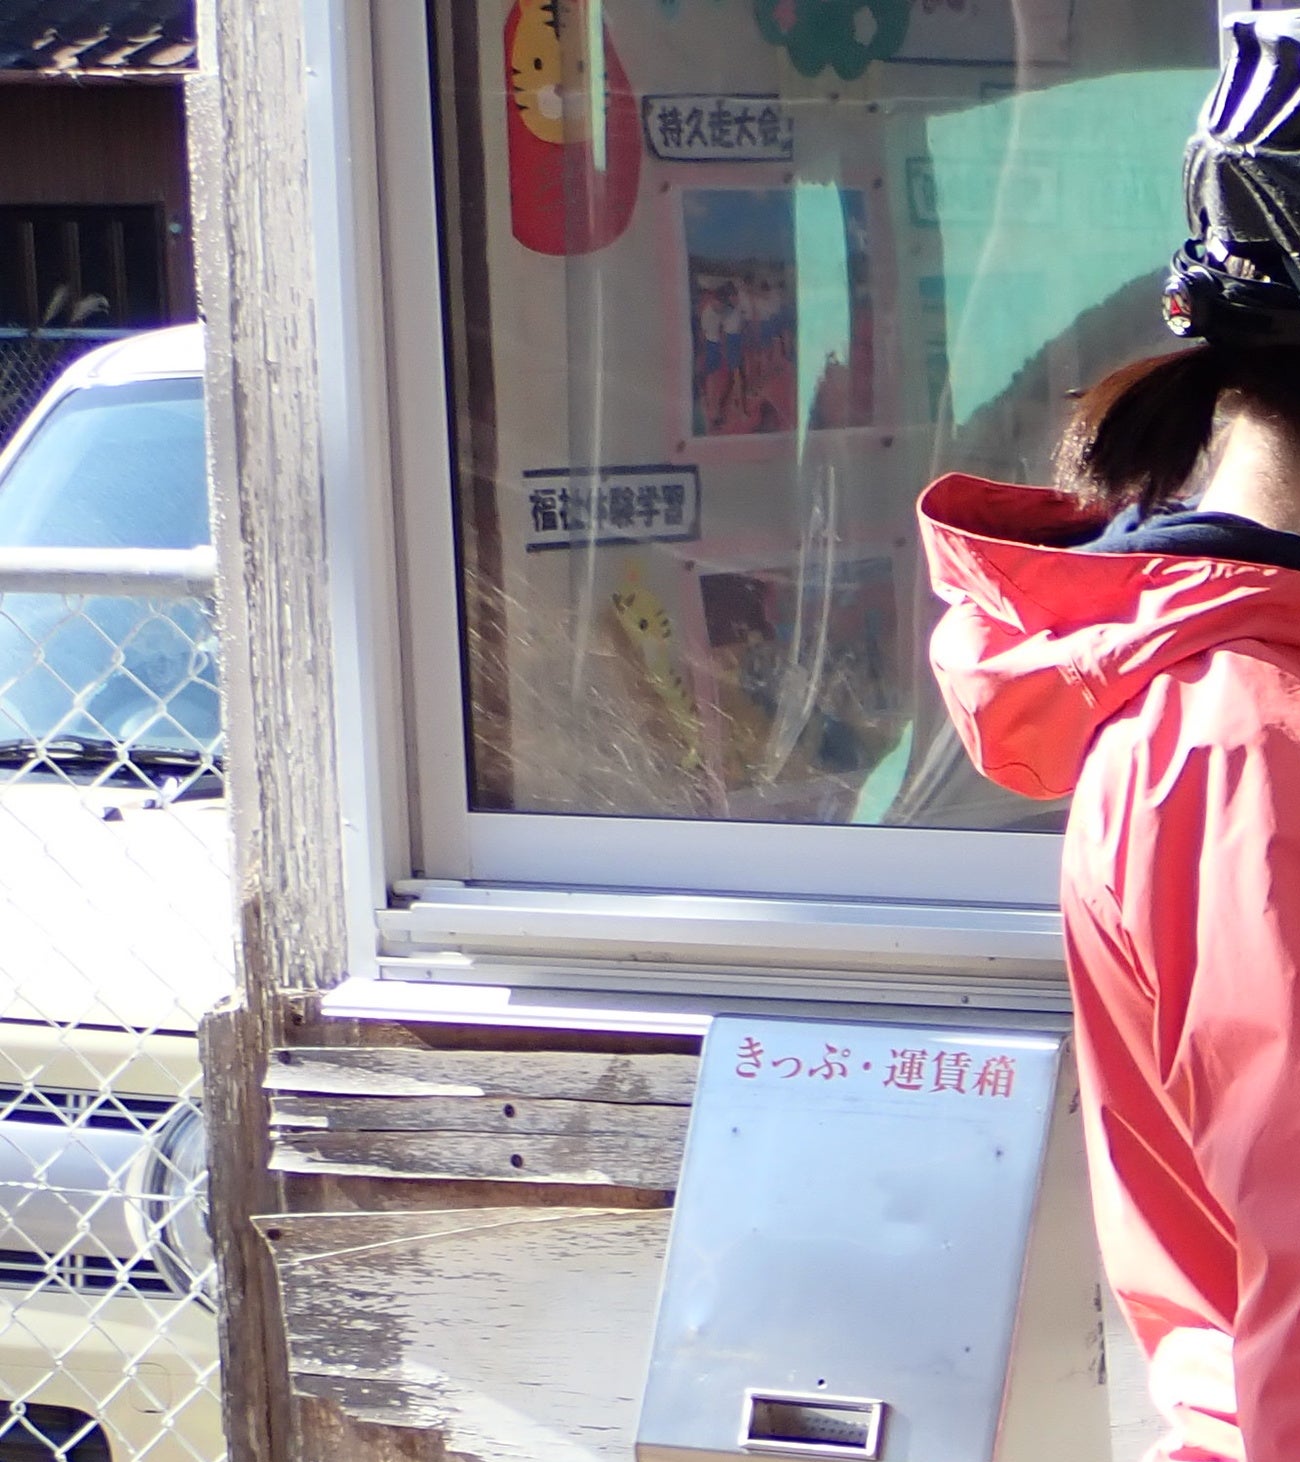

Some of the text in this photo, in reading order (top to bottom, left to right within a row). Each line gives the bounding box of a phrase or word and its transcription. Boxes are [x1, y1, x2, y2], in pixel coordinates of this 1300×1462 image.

[735, 1036, 1018, 1099] きっぷ・運賃箱
